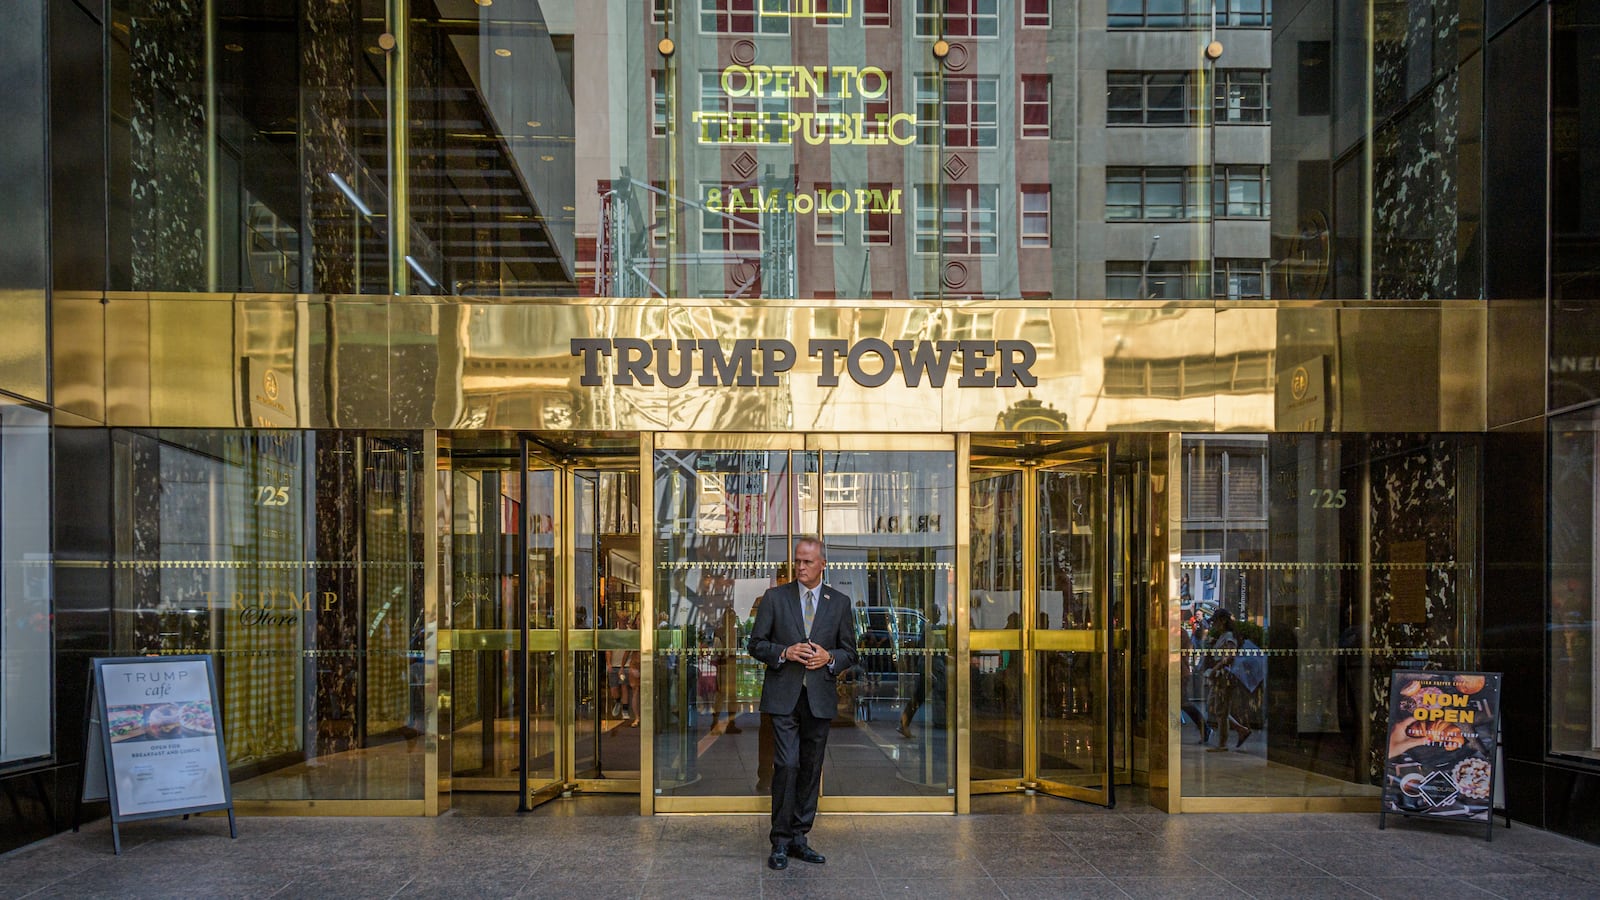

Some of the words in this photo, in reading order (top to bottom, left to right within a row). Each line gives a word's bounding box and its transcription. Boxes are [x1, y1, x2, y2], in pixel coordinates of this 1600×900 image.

[720, 65, 827, 98] OPEN
[832, 66, 888, 99] TO
[692, 111, 771, 144] THE
[778, 112, 917, 145] PUBLIC
[785, 192, 814, 214] to
[817, 189, 851, 214] 10
[854, 189, 902, 214] PM
[570, 337, 797, 388] TRUMP
[808, 337, 1038, 388] TOWER
[254, 486, 289, 506] 725
[1309, 488, 1347, 509] 725
[200, 591, 338, 611] TRUMP
[239, 604, 298, 627] Store
[122, 670, 189, 683] TRUMP
[145, 682, 172, 700] café
[1423, 693, 1469, 708] NOW
[1413, 707, 1475, 724] OPEN
